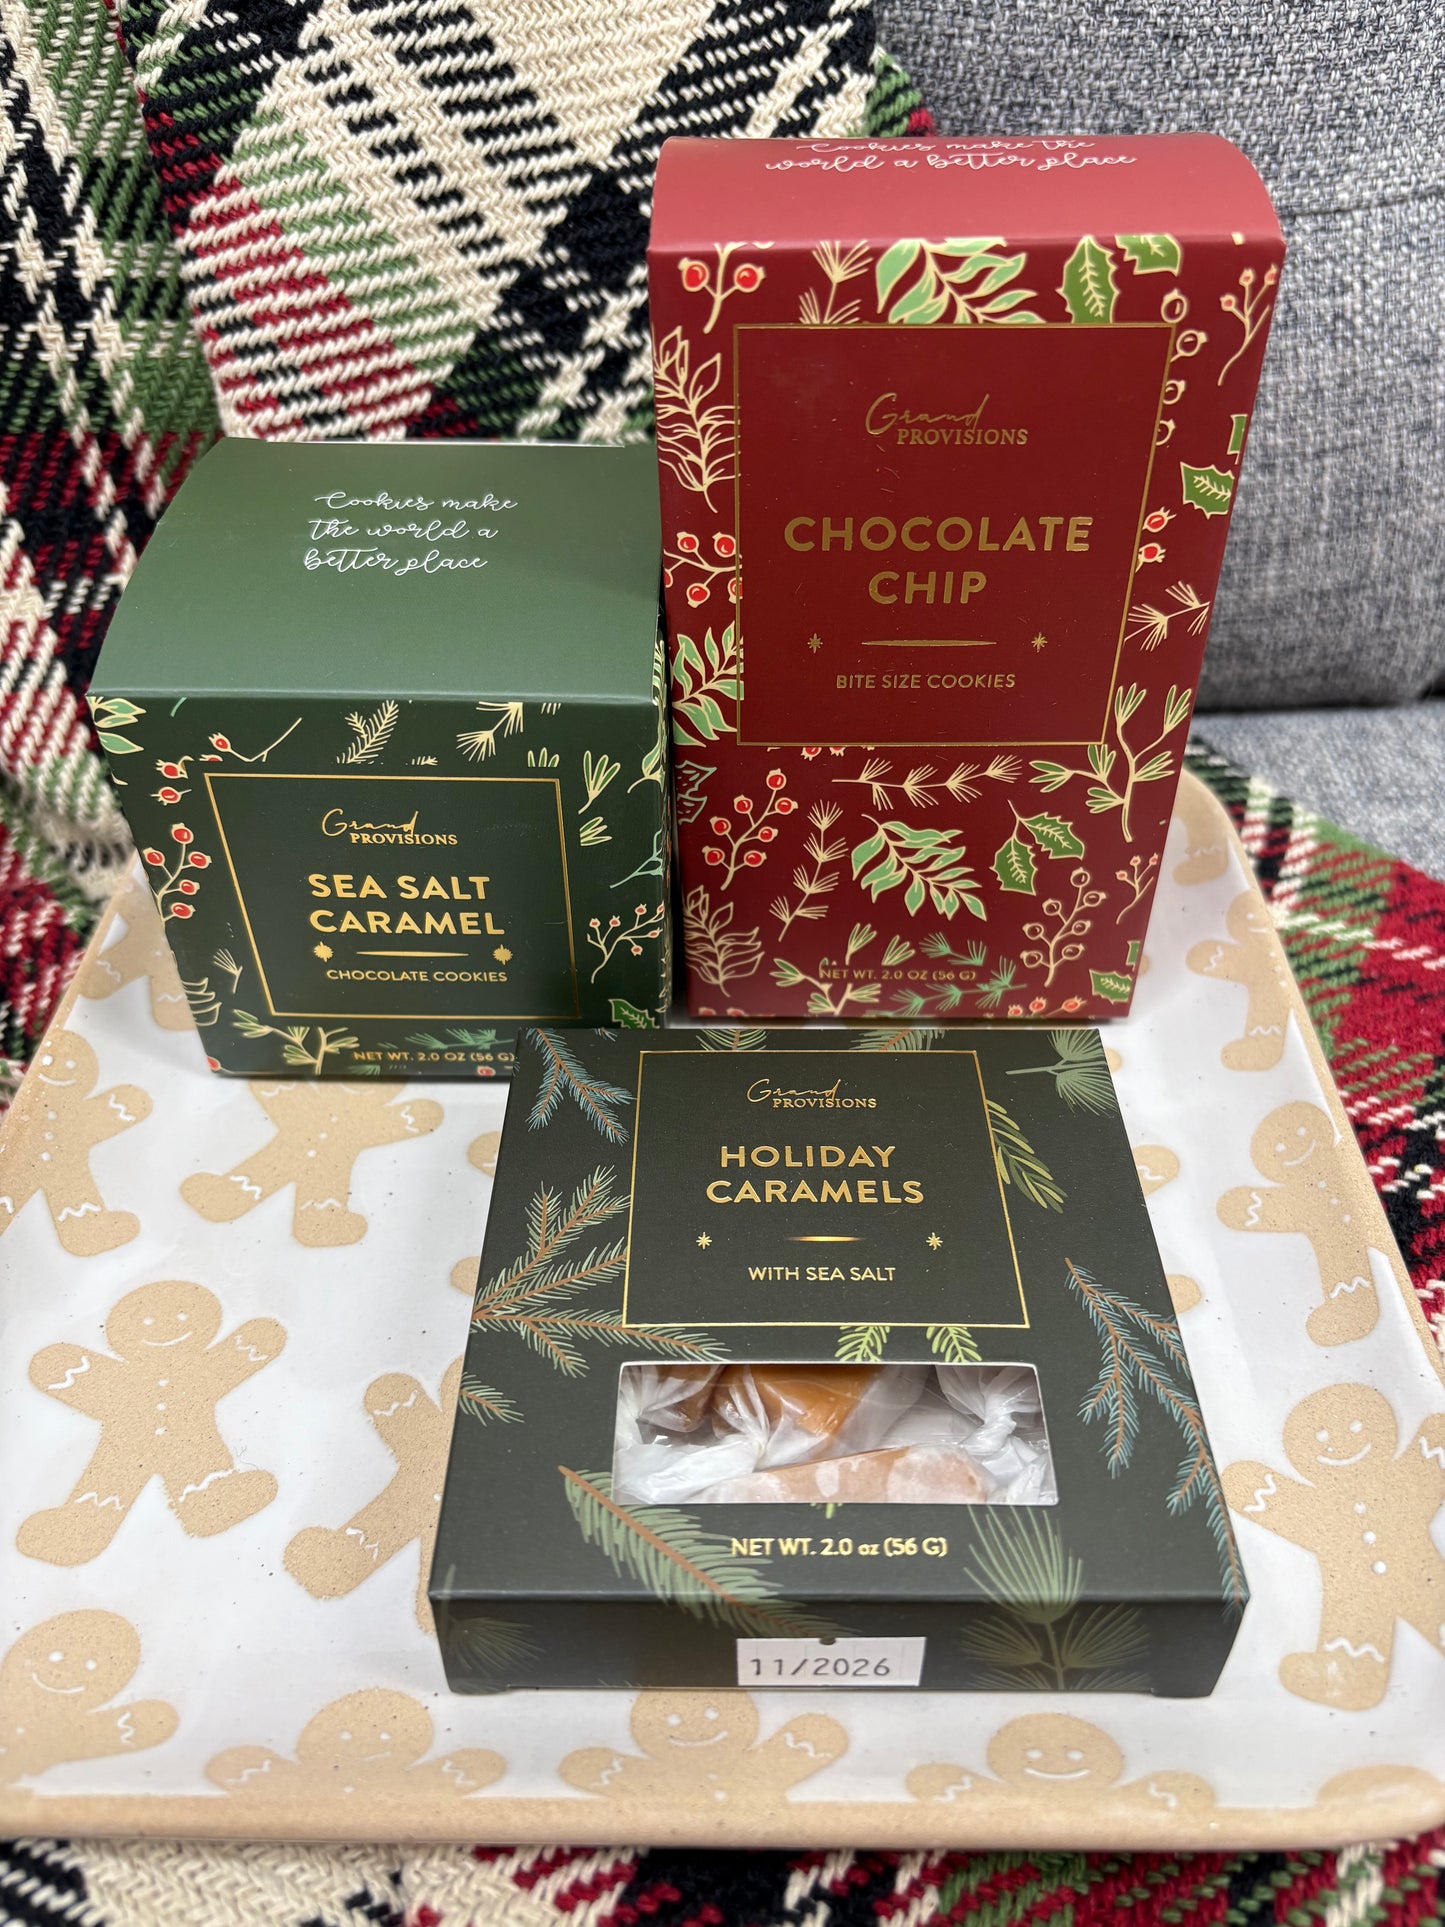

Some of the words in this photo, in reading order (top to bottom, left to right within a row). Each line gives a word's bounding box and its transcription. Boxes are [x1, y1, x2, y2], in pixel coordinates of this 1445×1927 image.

[797, 142, 935, 153] Cookies
[947, 141, 1034, 151] make
[1034, 139, 1096, 149] the
[766, 154, 884, 172] world
[894, 159, 919, 170] a
[928, 152, 1037, 171] better
[1036, 153, 1138, 172] place
[865, 392, 990, 435] Grand
[896, 428, 1029, 446] PROVISIONS
[314, 491, 435, 512] Cookies
[442, 493, 519, 512] make
[308, 519, 360, 541] the
[367, 519, 470, 542] world
[477, 529, 499, 539] a
[784, 516, 1094, 552] CHOCOLATE
[303, 547, 399, 573] better
[394, 549, 488, 577] place
[868, 571, 988, 605] CHIP
[836, 675, 876, 689] BITE
[881, 674, 922, 689] SIZE
[926, 673, 1016, 689] COOKIES
[321, 808, 419, 837] Grand
[350, 833, 458, 846] PROVISIONS
[307, 873, 387, 899] SEA
[396, 874, 490, 900] SALT
[309, 909, 505, 935] CARAMEL
[326, 969, 429, 982] CHOCOLATE
[433, 971, 508, 982] COOKIES
[820, 968, 849, 980] NET
[853, 969, 877, 980] WT.
[881, 969, 903, 980] 2.0
[907, 969, 927, 980] OZ
[932, 970, 955, 981] (56
[958, 970, 976, 980] G)
[353, 1051, 382, 1061] NET
[386, 1051, 414, 1061] WT.
[417, 1051, 441, 1062] 2.0
[444, 1052, 467, 1062] OZ
[470, 1052, 494, 1063] (56
[497, 1053, 515, 1063] G)
[746, 1078, 841, 1103] Grand
[772, 1098, 877, 1109] PROVISIONS
[720, 1145, 896, 1168] HOLIDAY
[706, 1179, 924, 1204] CARAMELS
[748, 1266, 800, 1281] WITH
[805, 1266, 845, 1281] SEA
[850, 1266, 896, 1281] SALT
[731, 1537, 774, 1556] NET
[779, 1537, 816, 1556] WT.
[820, 1538, 852, 1556] 2.0
[883, 1537, 918, 1557] (56
[921, 1537, 948, 1558] G)
[750, 1657, 890, 1677] 11/2026
